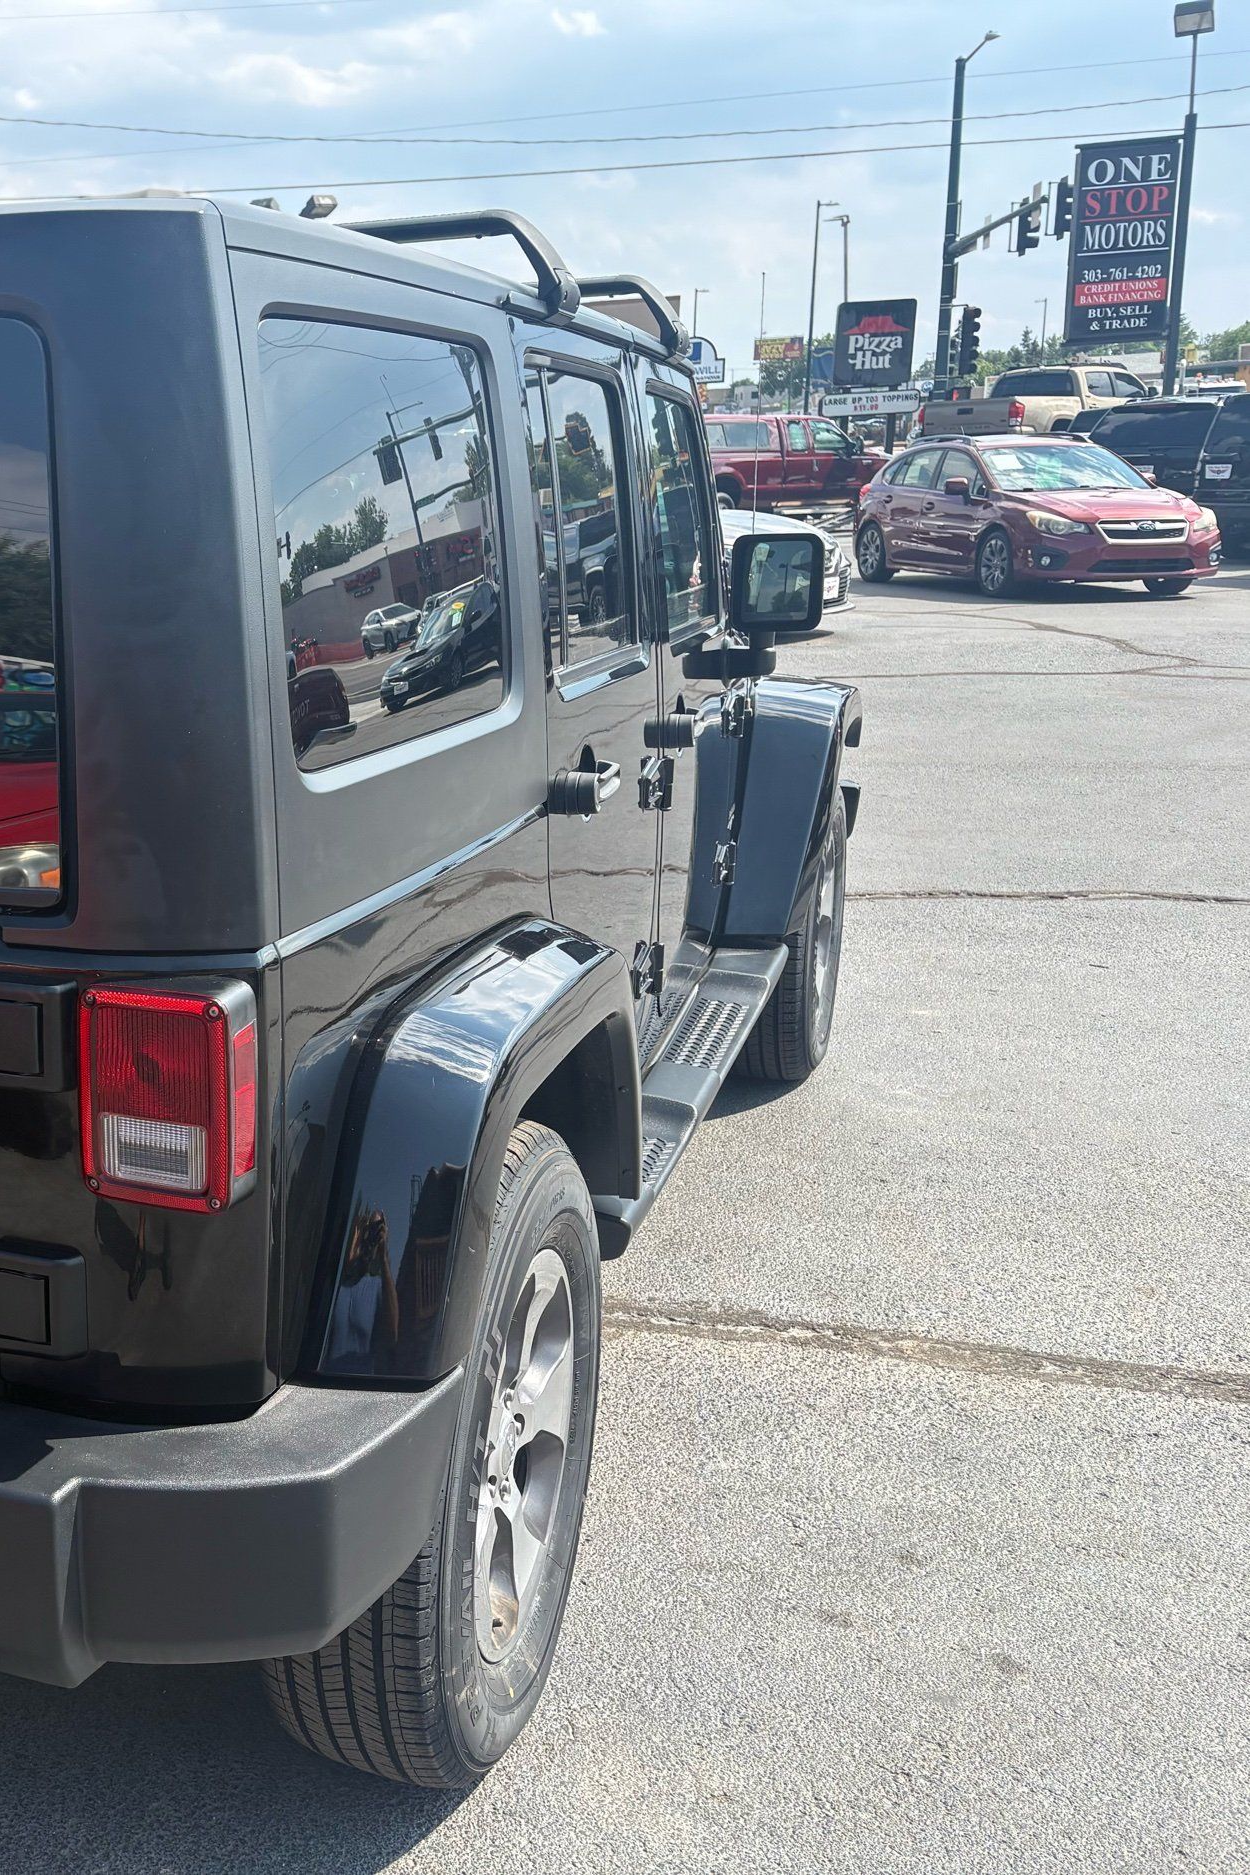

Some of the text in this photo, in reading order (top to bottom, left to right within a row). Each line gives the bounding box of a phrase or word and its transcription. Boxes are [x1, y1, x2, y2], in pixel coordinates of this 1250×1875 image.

[1087, 153, 1172, 185] ONE
[1085, 186, 1169, 217] STOP
[1083, 219, 1167, 251] MOTORS
[1084, 280, 1159, 294] CREDIT UNIONS
[1080, 290, 1162, 304] BANK FINANCING
[1088, 304, 1152, 318] BUY, SELL
[1090, 317, 1148, 331] & TRADE
[847, 333, 903, 354] Pizza
[847, 350, 892, 370] Hut
[694, 366, 721, 375] WILL
[824, 397, 848, 406] LARGE
[852, 396, 863, 404] UP
[882, 393, 919, 402] TOPPINGS
[466, 1420, 486, 1522] H/T
